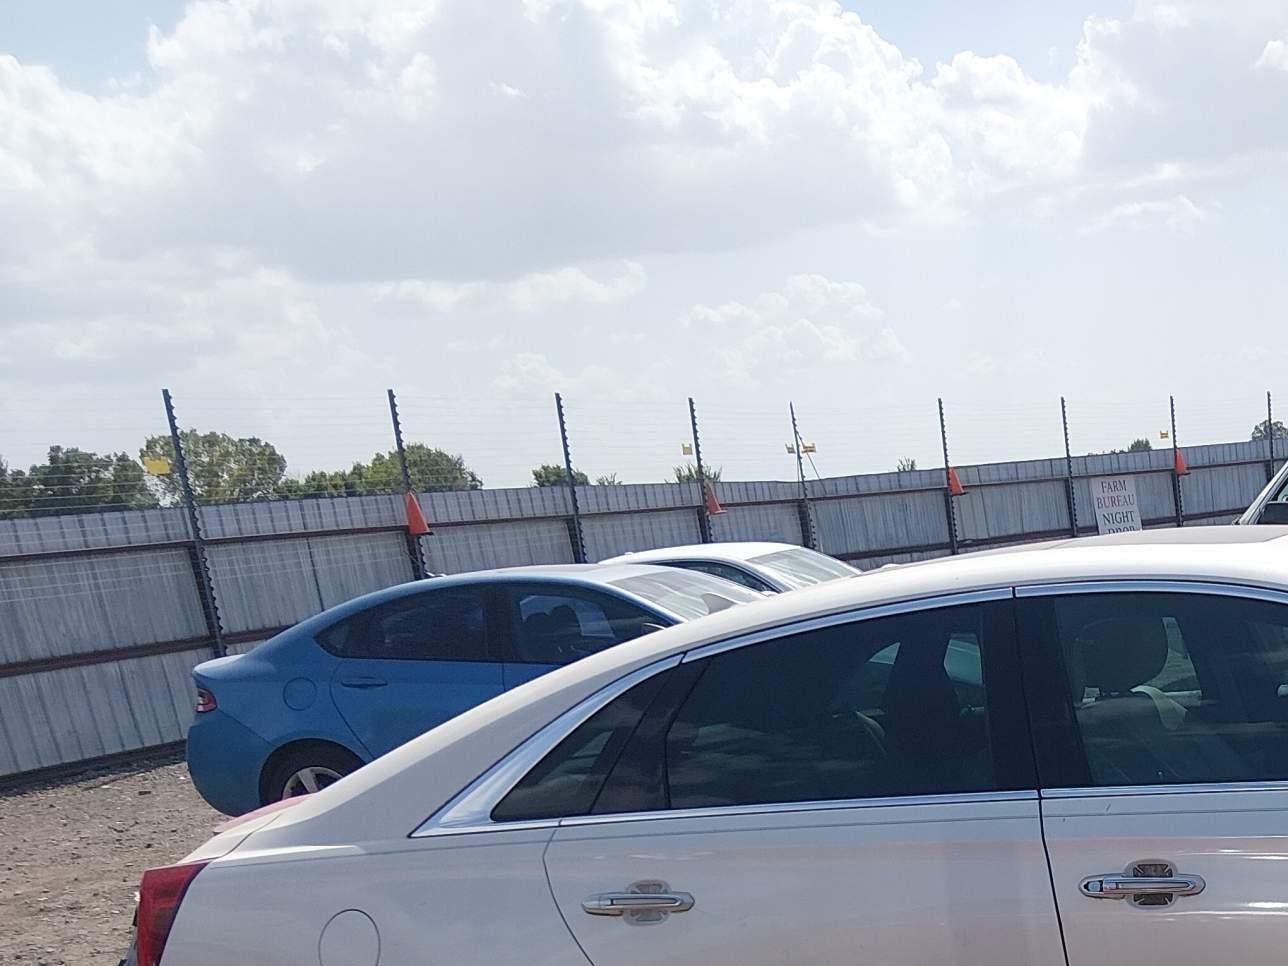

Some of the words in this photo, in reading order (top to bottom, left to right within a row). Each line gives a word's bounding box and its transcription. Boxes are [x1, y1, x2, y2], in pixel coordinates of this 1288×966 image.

[1101, 480, 1127, 493] FARM
[1096, 494, 1135, 509] BUREAU
[1103, 511, 1134, 525] NIGHT
